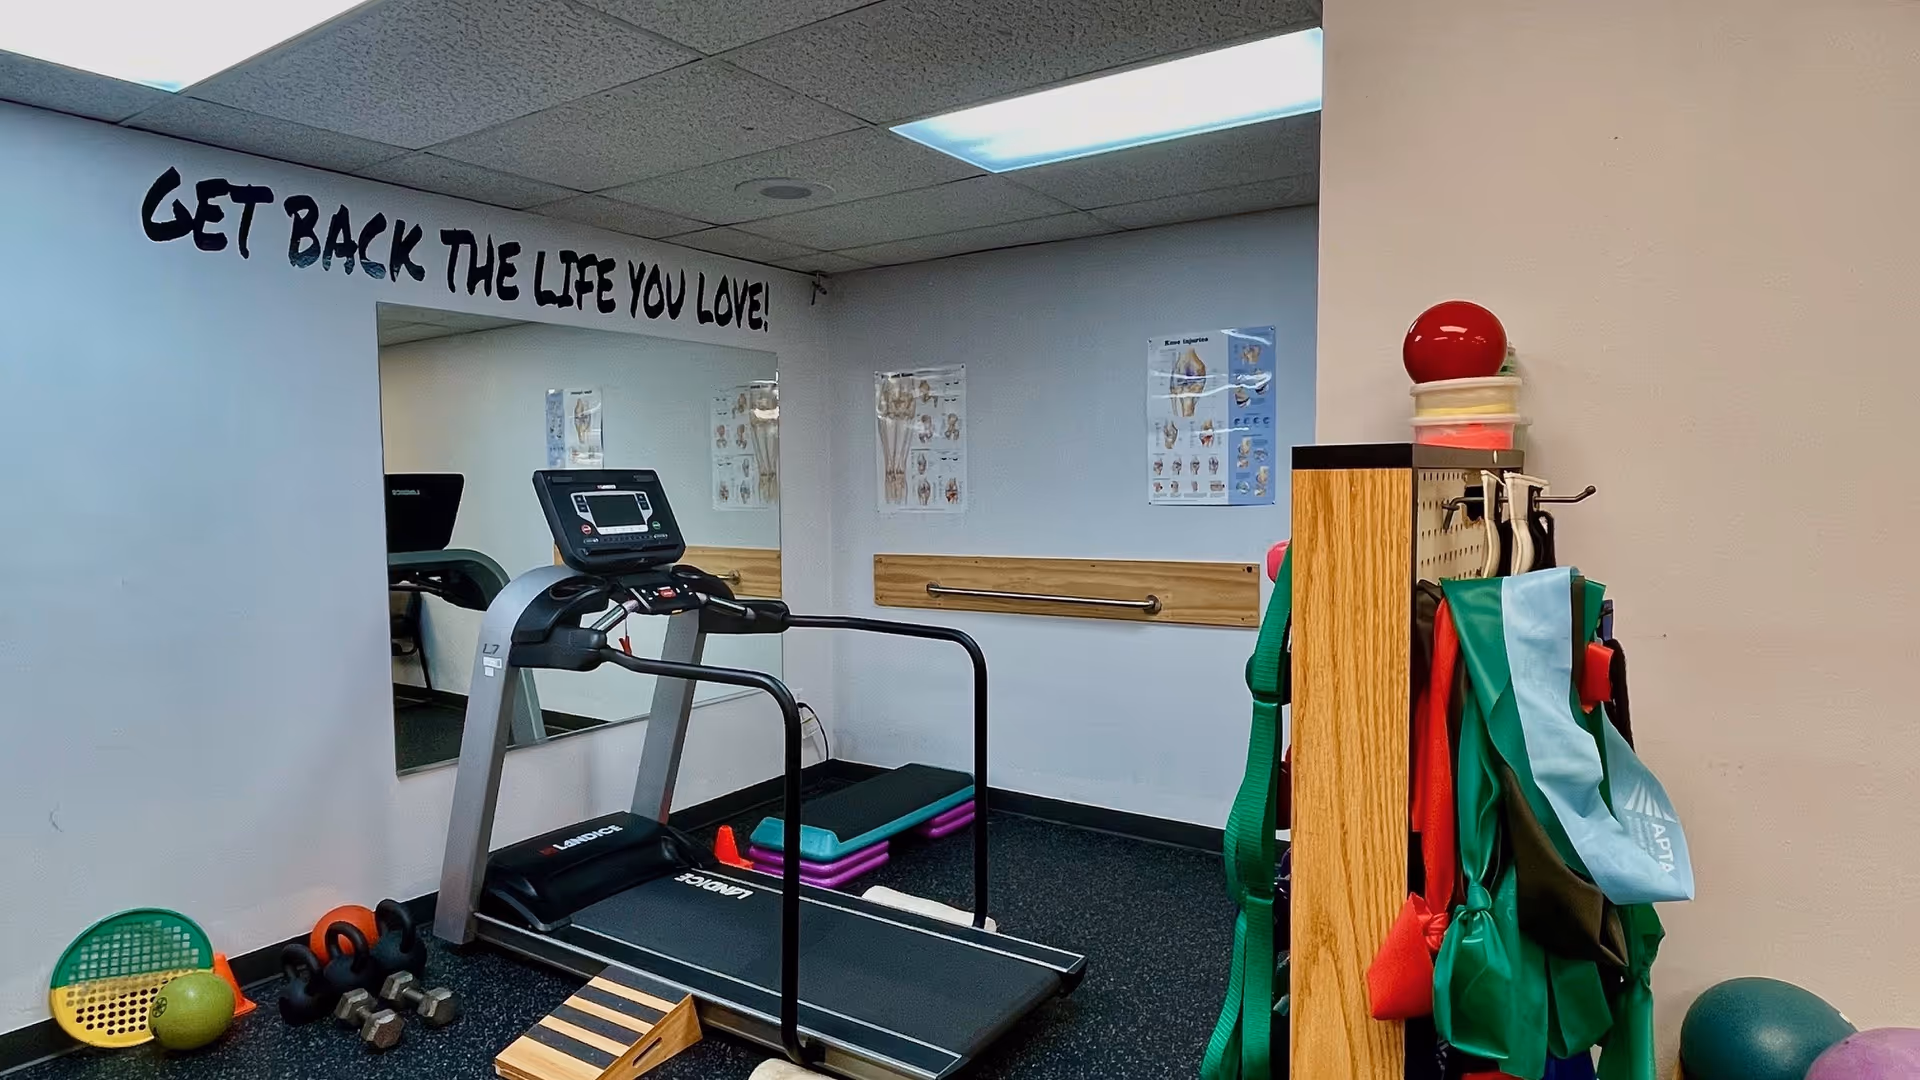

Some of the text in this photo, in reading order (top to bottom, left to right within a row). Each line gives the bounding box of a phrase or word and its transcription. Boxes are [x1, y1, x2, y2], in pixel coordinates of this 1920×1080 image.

[141, 166, 771, 332] GET BACK THE LIFE YOU LOVE!
[482, 643, 500, 655] L7
[552, 824, 623, 851] LANDICE
[1651, 822, 1675, 872] APTA
[674, 872, 754, 900] LANDICE
